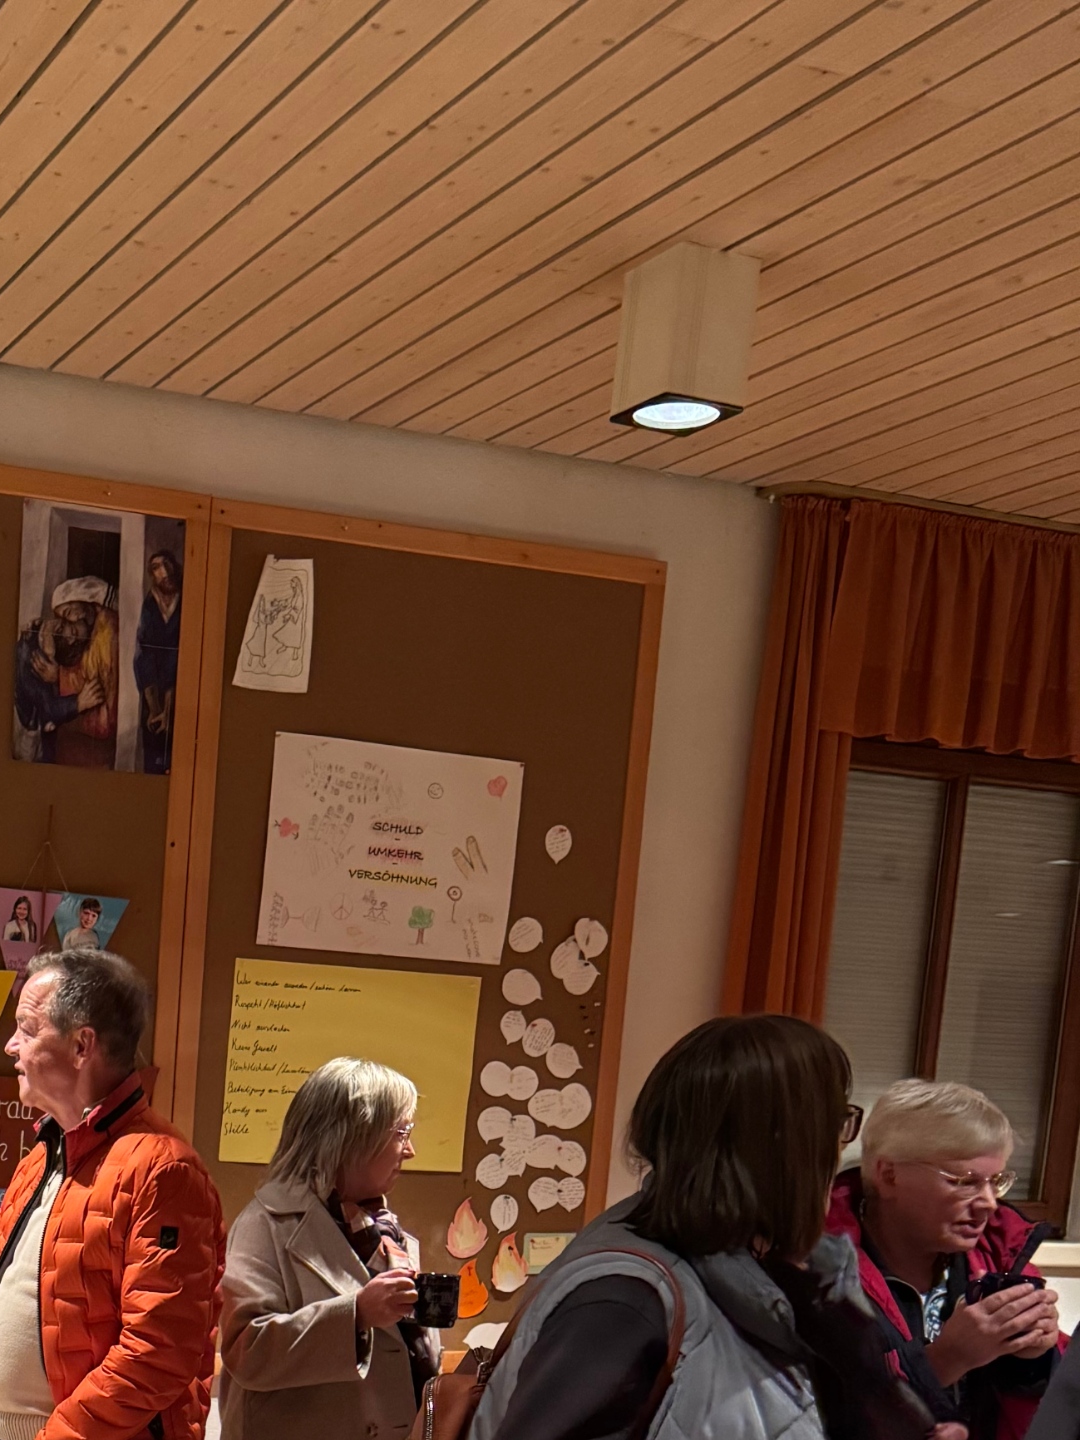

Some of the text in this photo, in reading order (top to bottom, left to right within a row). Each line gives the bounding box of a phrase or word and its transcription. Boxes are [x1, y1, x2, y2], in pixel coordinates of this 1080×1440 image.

[372, 822, 424, 835] SCHULD
[368, 846, 424, 861] UMKEHR
[348, 869, 438, 888] VERSÖHNUNG
[231, 1019, 251, 1030] Nicht
[252, 1040, 277, 1056] Gewalt
[223, 1101, 251, 1118] Handy
[224, 1121, 250, 1136] Stille
